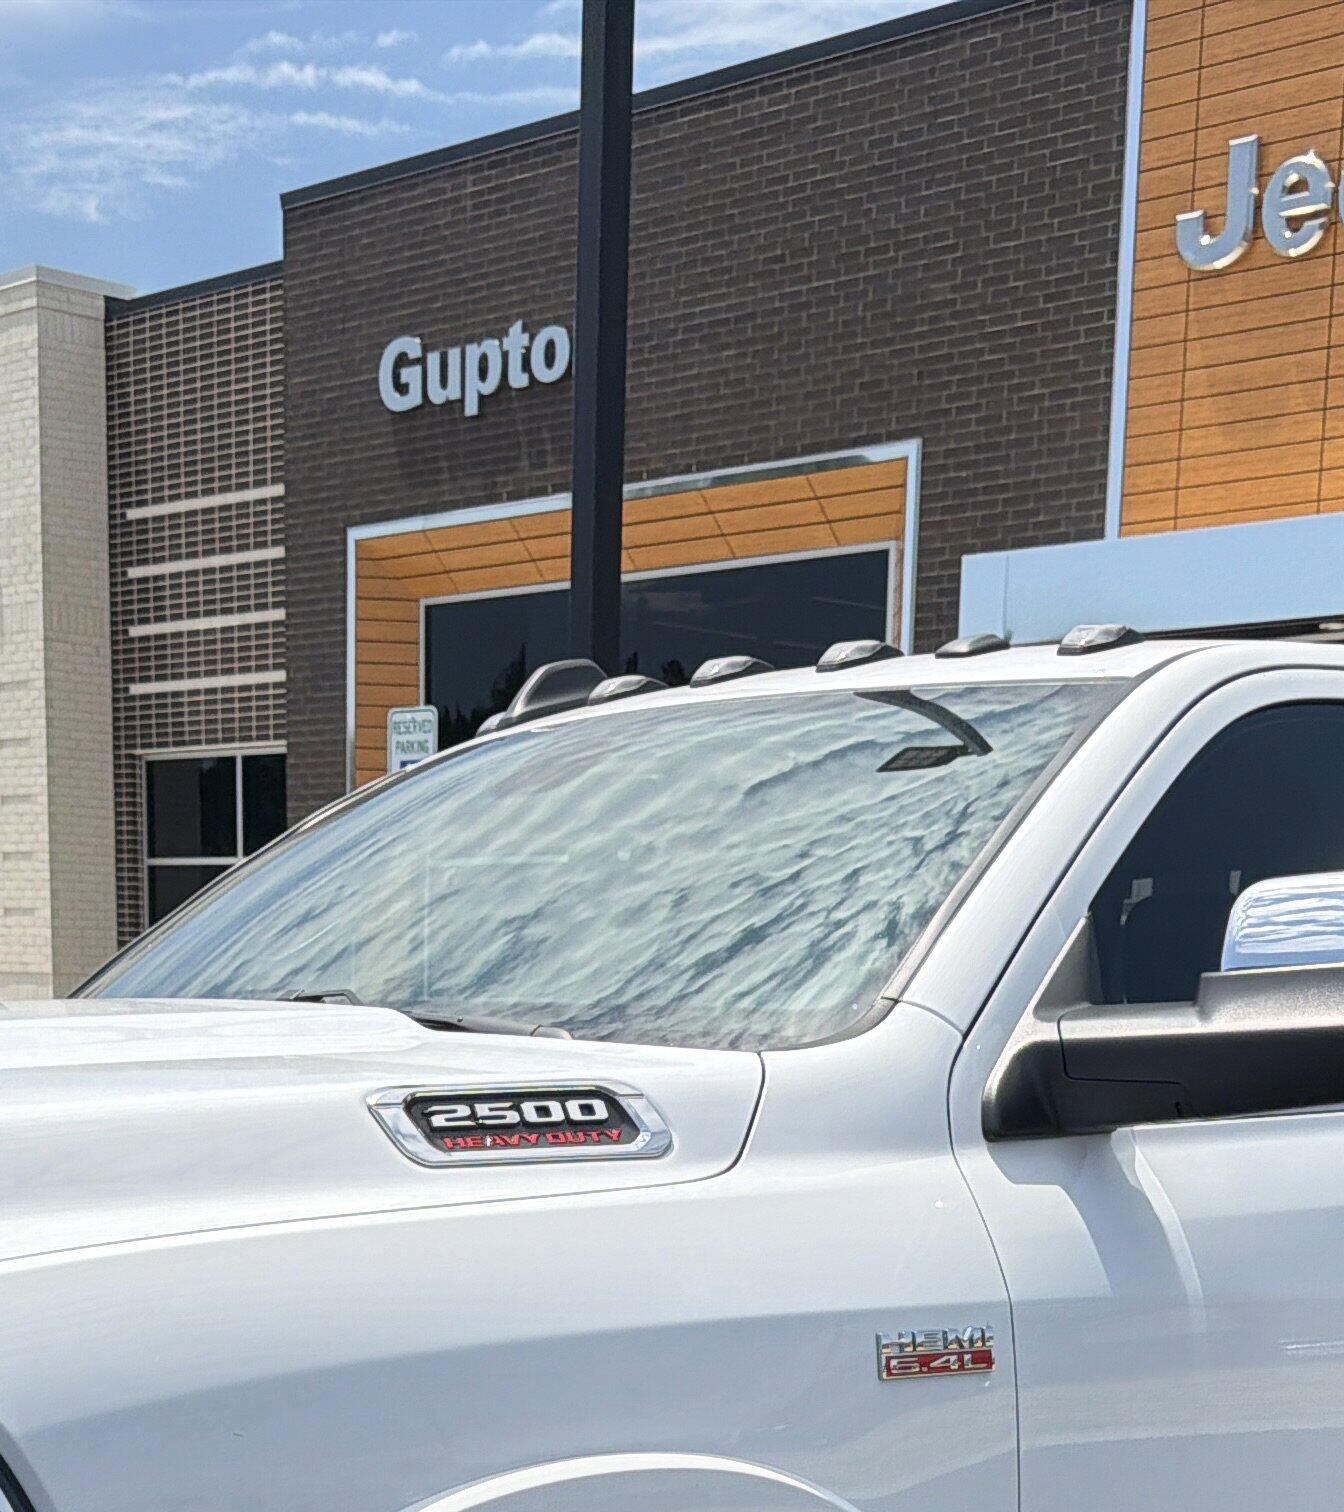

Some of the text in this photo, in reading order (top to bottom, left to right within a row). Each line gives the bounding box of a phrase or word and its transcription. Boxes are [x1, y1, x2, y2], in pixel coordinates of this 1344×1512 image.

[395, 739, 429, 754] PARKING
[426, 1099, 609, 1129] 2500
[443, 1128, 622, 1149] HEAVY DUTY
